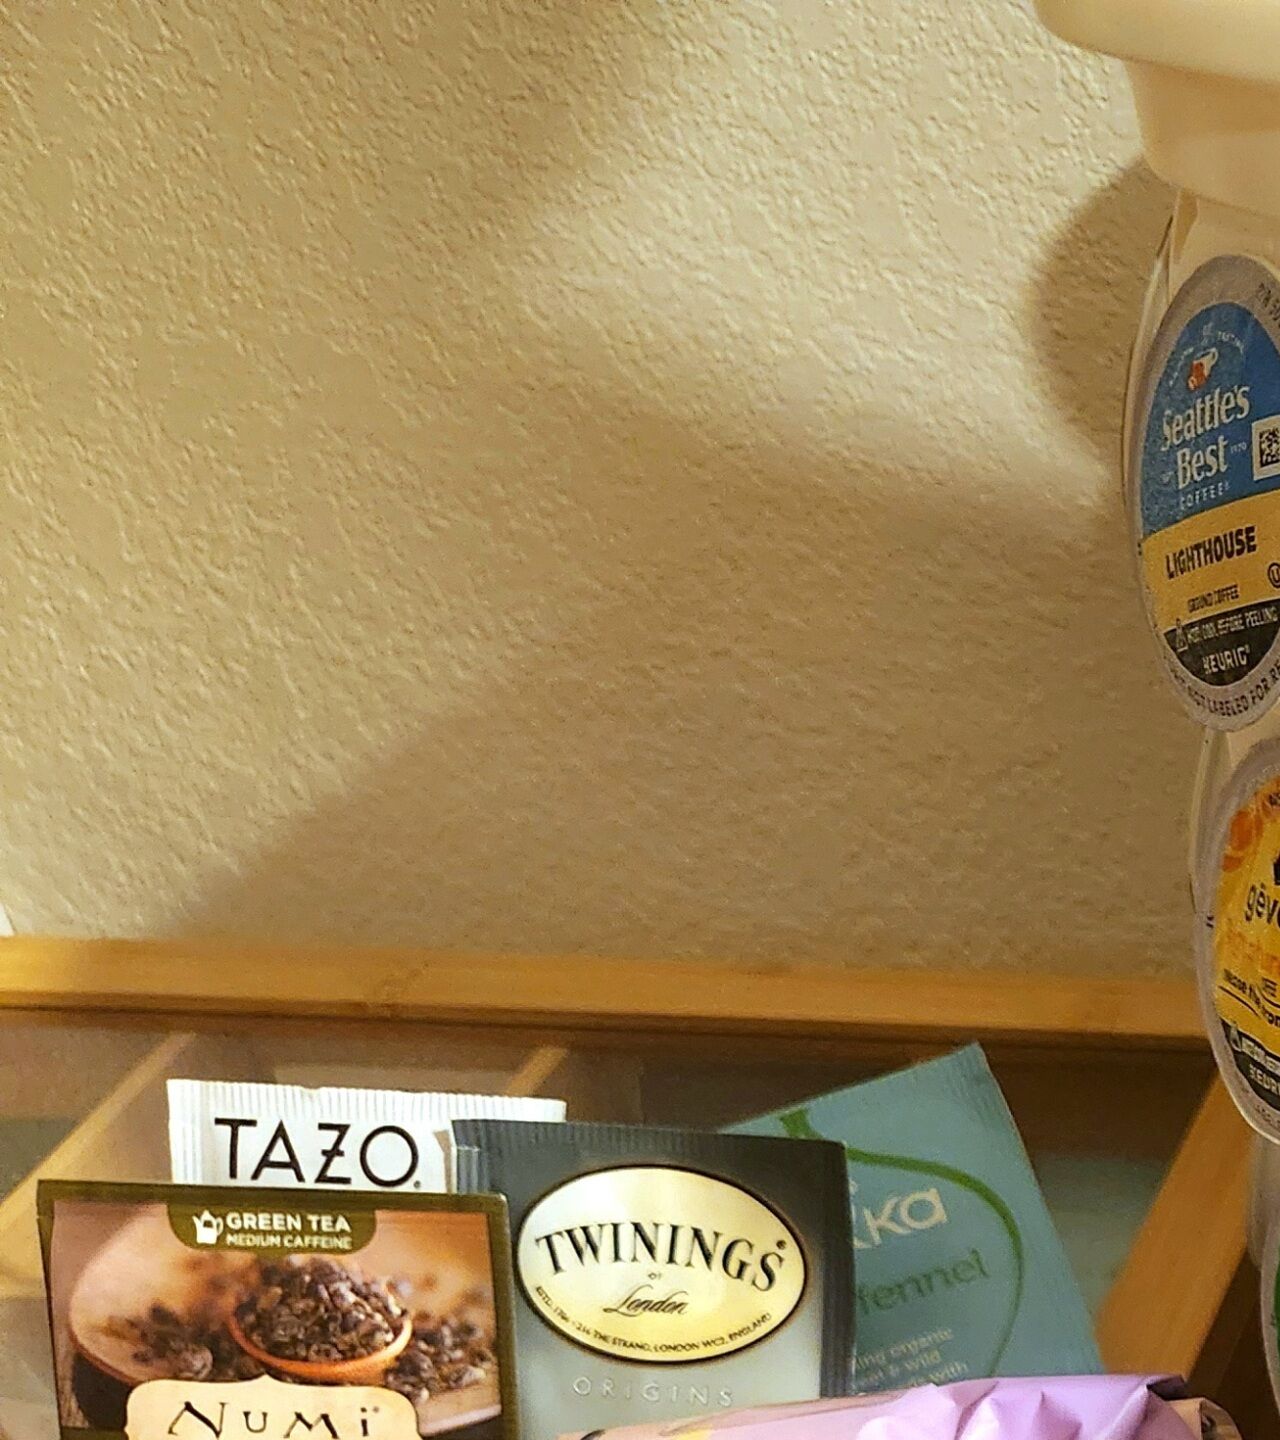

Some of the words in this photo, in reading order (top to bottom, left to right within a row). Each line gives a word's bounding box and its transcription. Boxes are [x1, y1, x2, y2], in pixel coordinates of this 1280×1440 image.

[1177, 435, 1228, 489] Best
[1166, 526, 1257, 579] LIGHTHOUSE
[214, 1117, 419, 1188] TAZO
[226, 1212, 302, 1230] GREEN
[306, 1214, 351, 1232] TEA
[226, 1233, 281, 1247] MEDIUM
[283, 1235, 352, 1249] CAFFEINE
[535, 1221, 785, 1292] TWININGS
[603, 1284, 688, 1320] London
[653, 1341, 700, 1352] LONDON
[573, 1376, 733, 1407] ORIGINS
